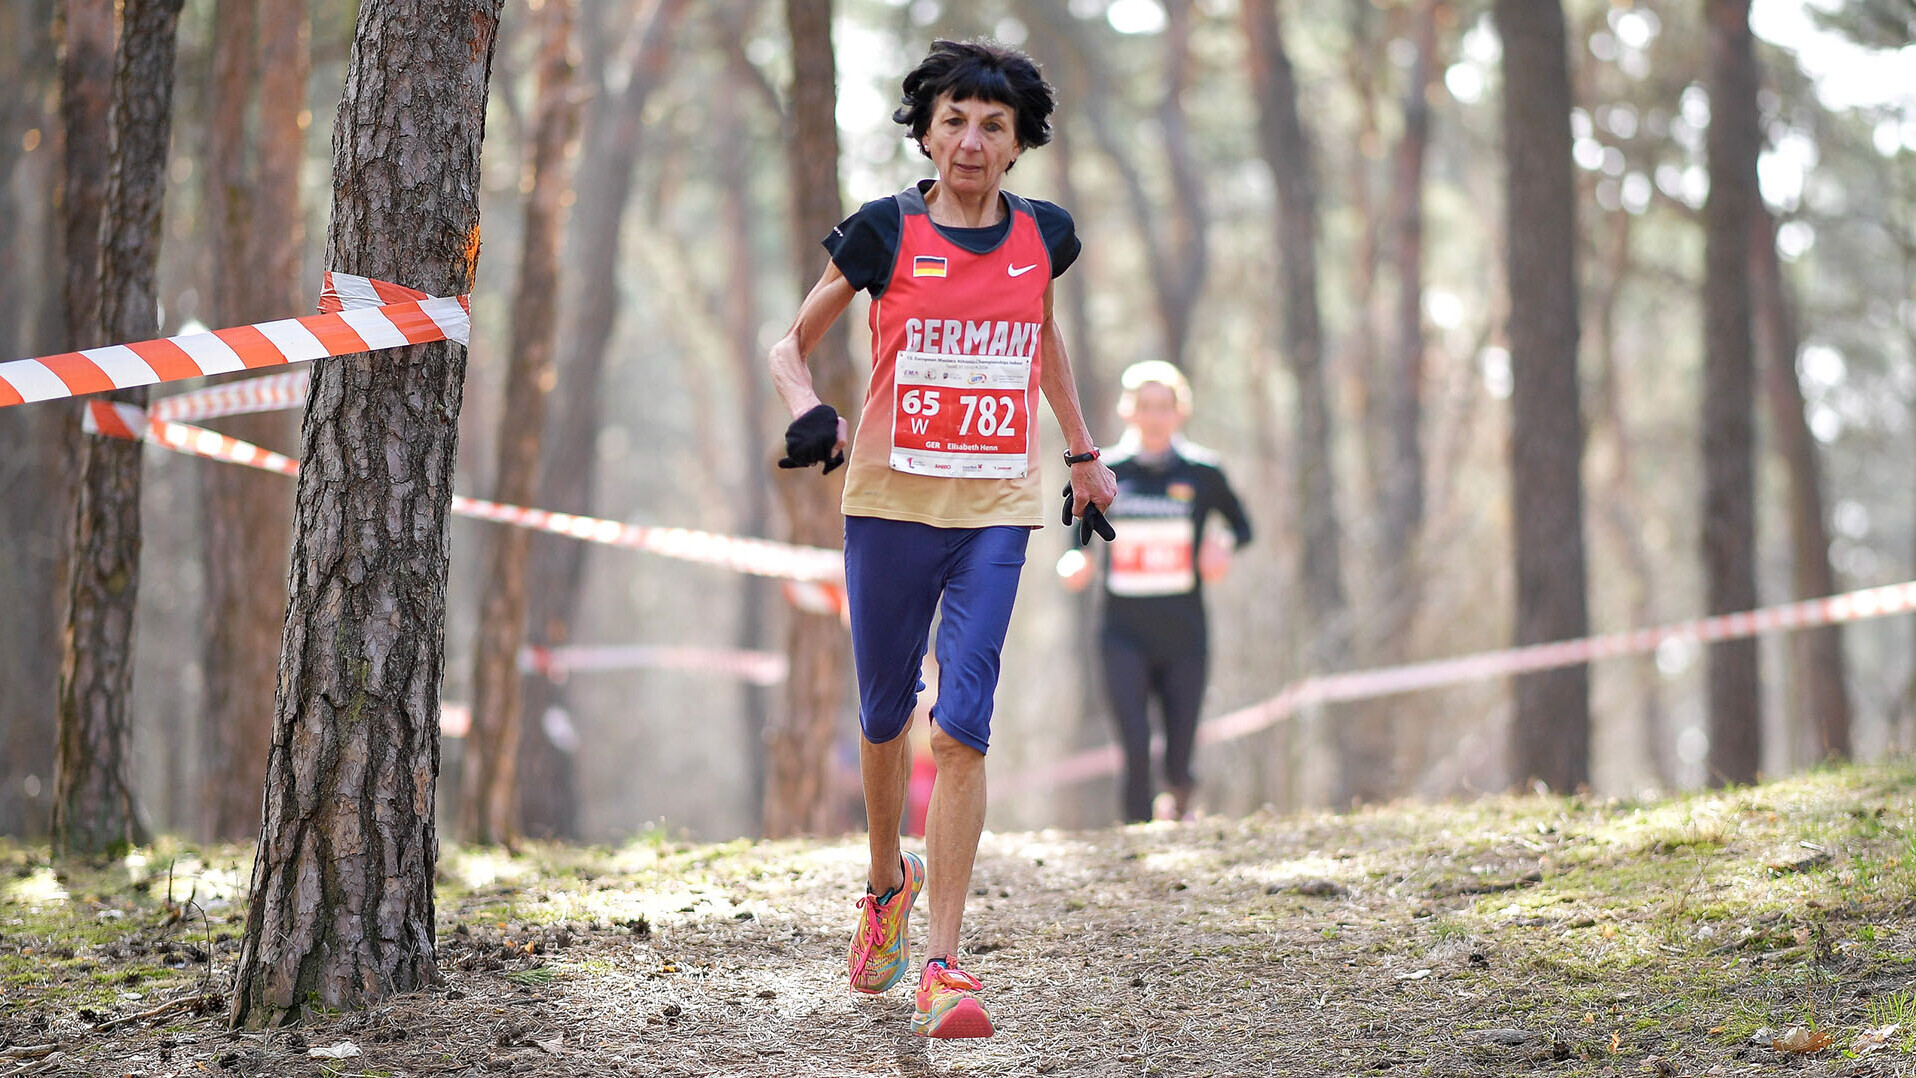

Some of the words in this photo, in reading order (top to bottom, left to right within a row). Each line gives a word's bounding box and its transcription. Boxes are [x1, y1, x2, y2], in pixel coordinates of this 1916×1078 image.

[905, 318, 1041, 357] GERMANY
[902, 389, 940, 416] 65
[959, 395, 1015, 437] 782
[911, 417, 929, 435] W
[925, 440, 941, 449] GER
[947, 442, 979, 451] Elisabeth
